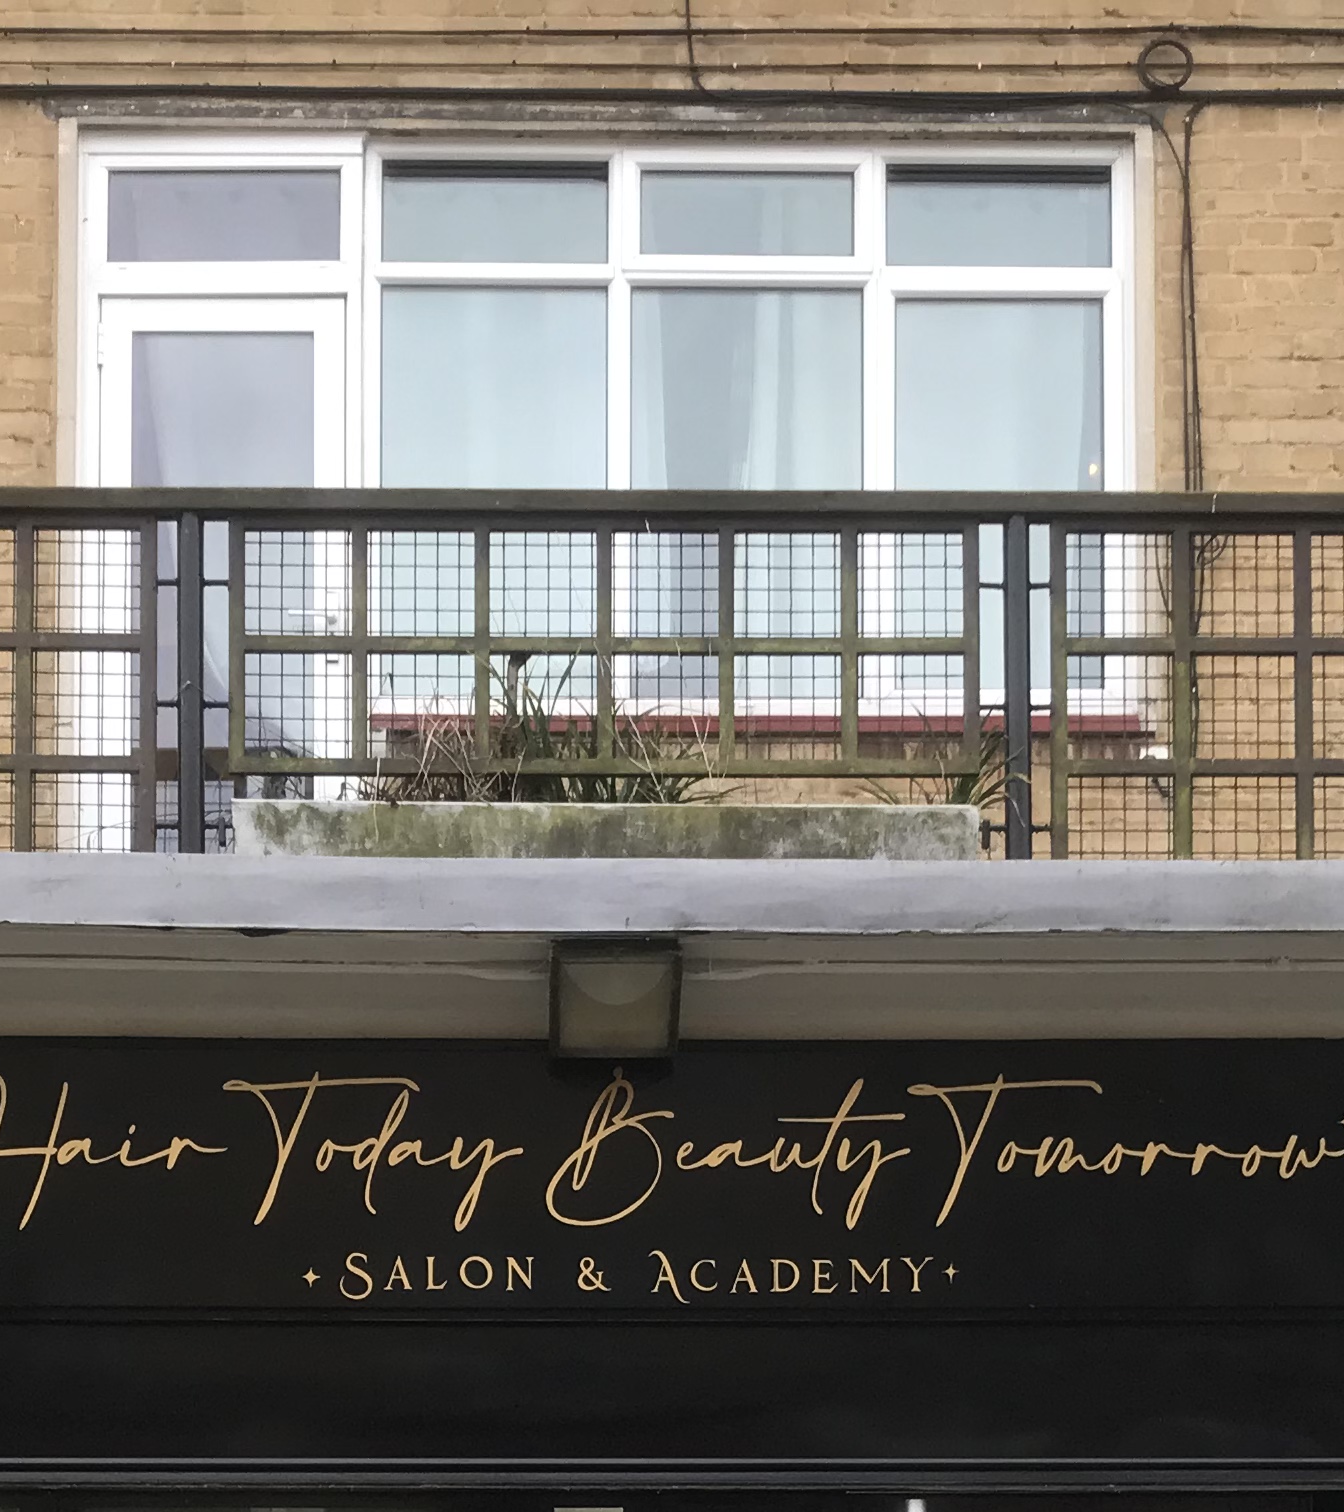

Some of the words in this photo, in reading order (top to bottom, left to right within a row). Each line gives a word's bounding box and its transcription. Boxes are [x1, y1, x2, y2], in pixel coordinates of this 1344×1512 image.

[223, 1071, 524, 1232] Today
[545, 1066, 912, 1229] Beauty
[340, 1252, 535, 1300] SALON
[577, 1257, 612, 1292] &
[646, 1248, 935, 1304] ACADEMY
